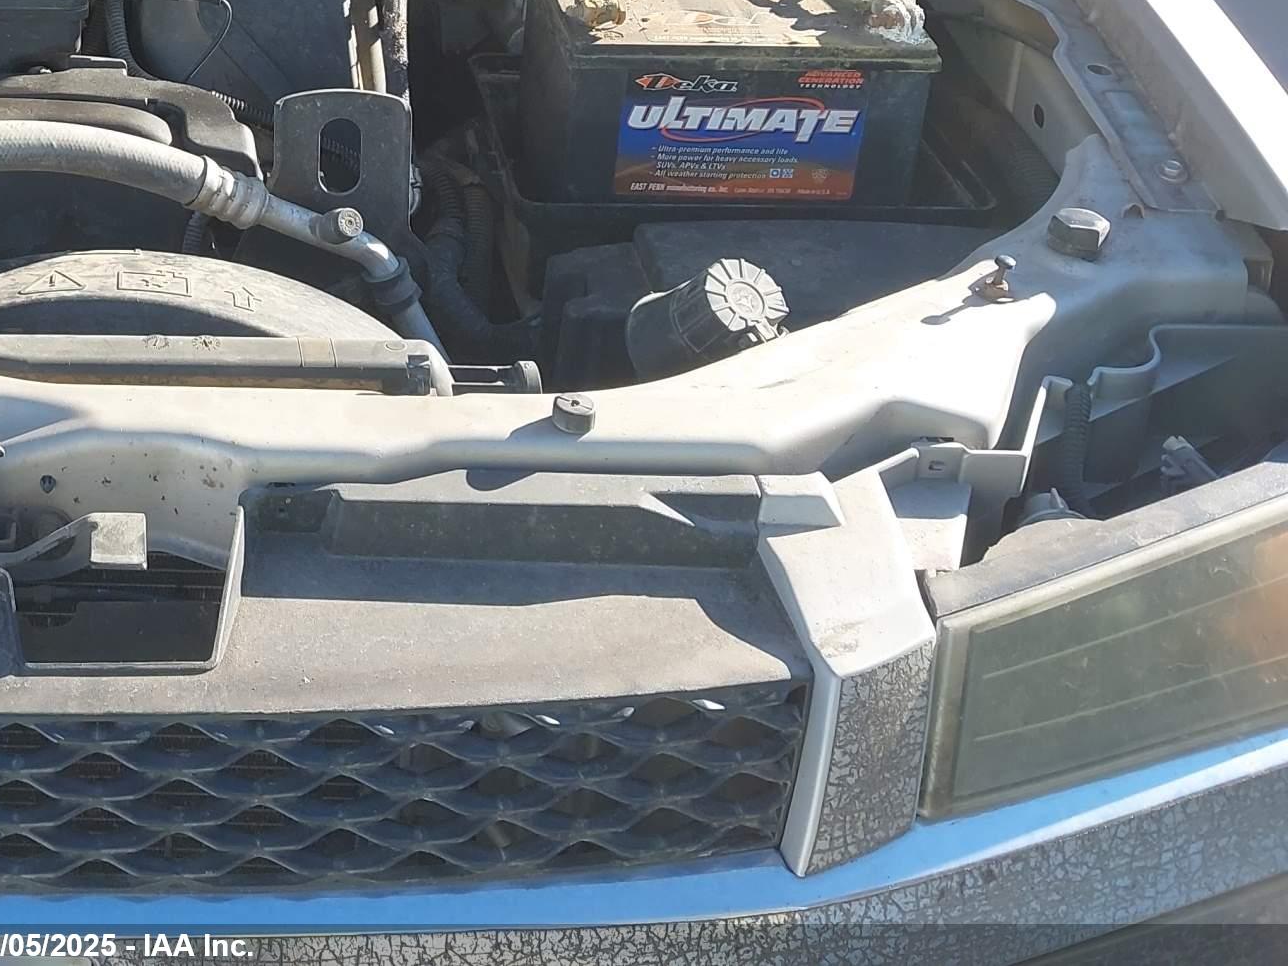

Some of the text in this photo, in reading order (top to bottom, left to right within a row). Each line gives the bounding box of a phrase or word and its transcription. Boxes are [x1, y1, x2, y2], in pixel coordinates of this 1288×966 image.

[635, 73, 737, 93] Deka
[627, 96, 860, 142] ULTIMATE
[712, 147, 759, 155] performance
[678, 155, 702, 163] power
[715, 155, 737, 163] heavy
[738, 155, 776, 163] accessory
[700, 171, 727, 179] starting
[728, 171, 766, 179] protection
